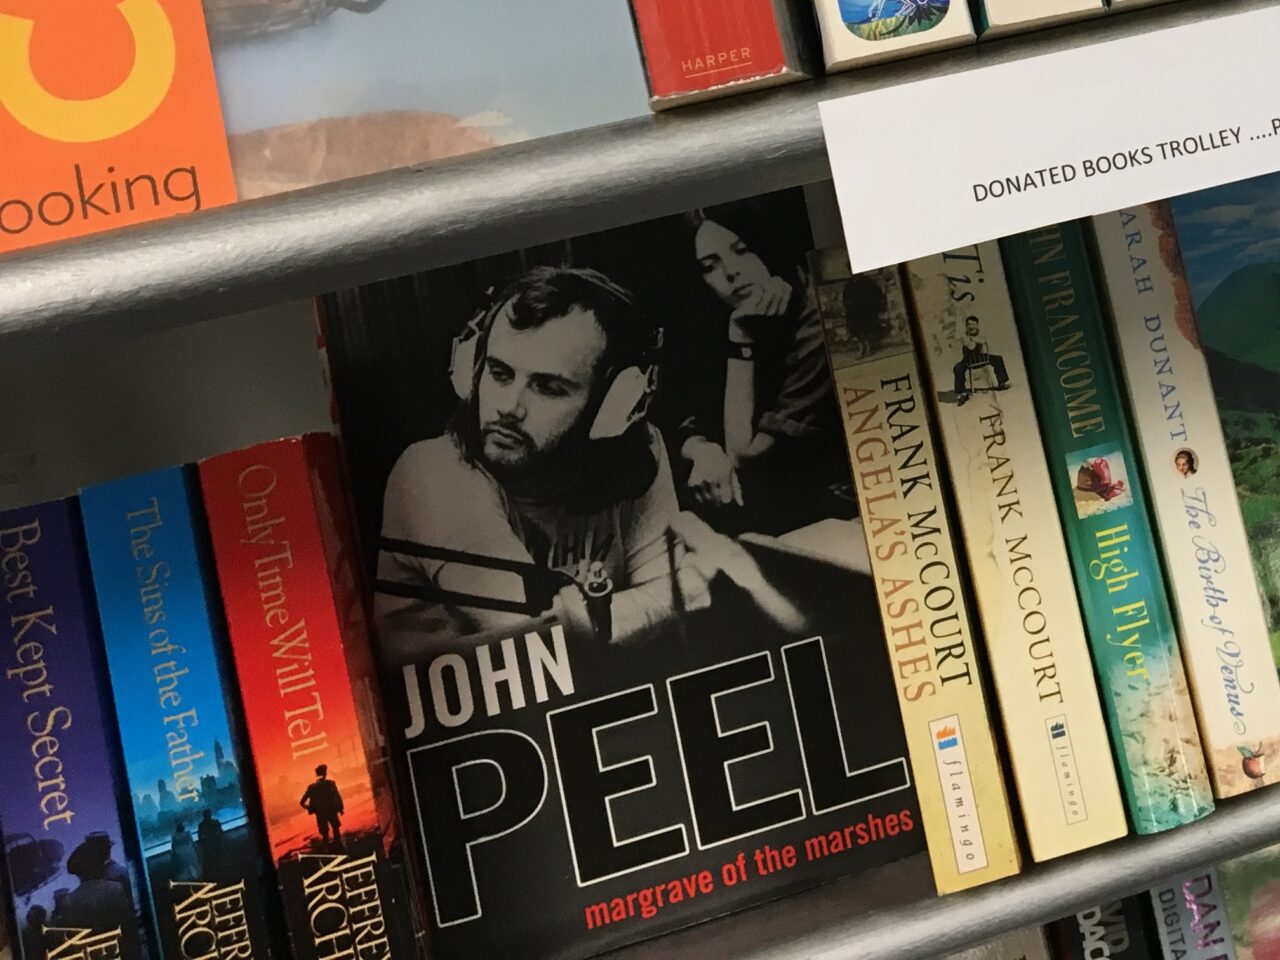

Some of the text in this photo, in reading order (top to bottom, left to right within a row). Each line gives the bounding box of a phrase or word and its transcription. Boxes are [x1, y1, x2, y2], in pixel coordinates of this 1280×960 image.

[682, 47, 752, 73] HARPER
[972, 164, 1077, 202] DONATED
[1082, 146, 1154, 178] BOOKS
[1156, 127, 1243, 161] TROLLEY
[1038, 270, 1106, 438] FRANCOME
[1144, 314, 1188, 442] DUNANT
[880, 373, 932, 499] FRANK
[979, 414, 1024, 524] FRANK
[843, 387, 936, 703] ANGELA'S ASHES
[1090, 524, 1150, 681] High Flyer
[1, 518, 76, 830] Best Kept Secret
[126, 496, 201, 805] The Sins of the Father
[237, 464, 330, 761] Only Time Will Tell
[1180, 487, 1255, 735] The Birth Venus
[402, 625, 576, 740] JOHN
[407, 635, 910, 929] PEEL
[943, 759, 975, 861] flamingo
[1056, 745, 1079, 817] flamingo
[585, 809, 915, 930] margrave of the marshes
